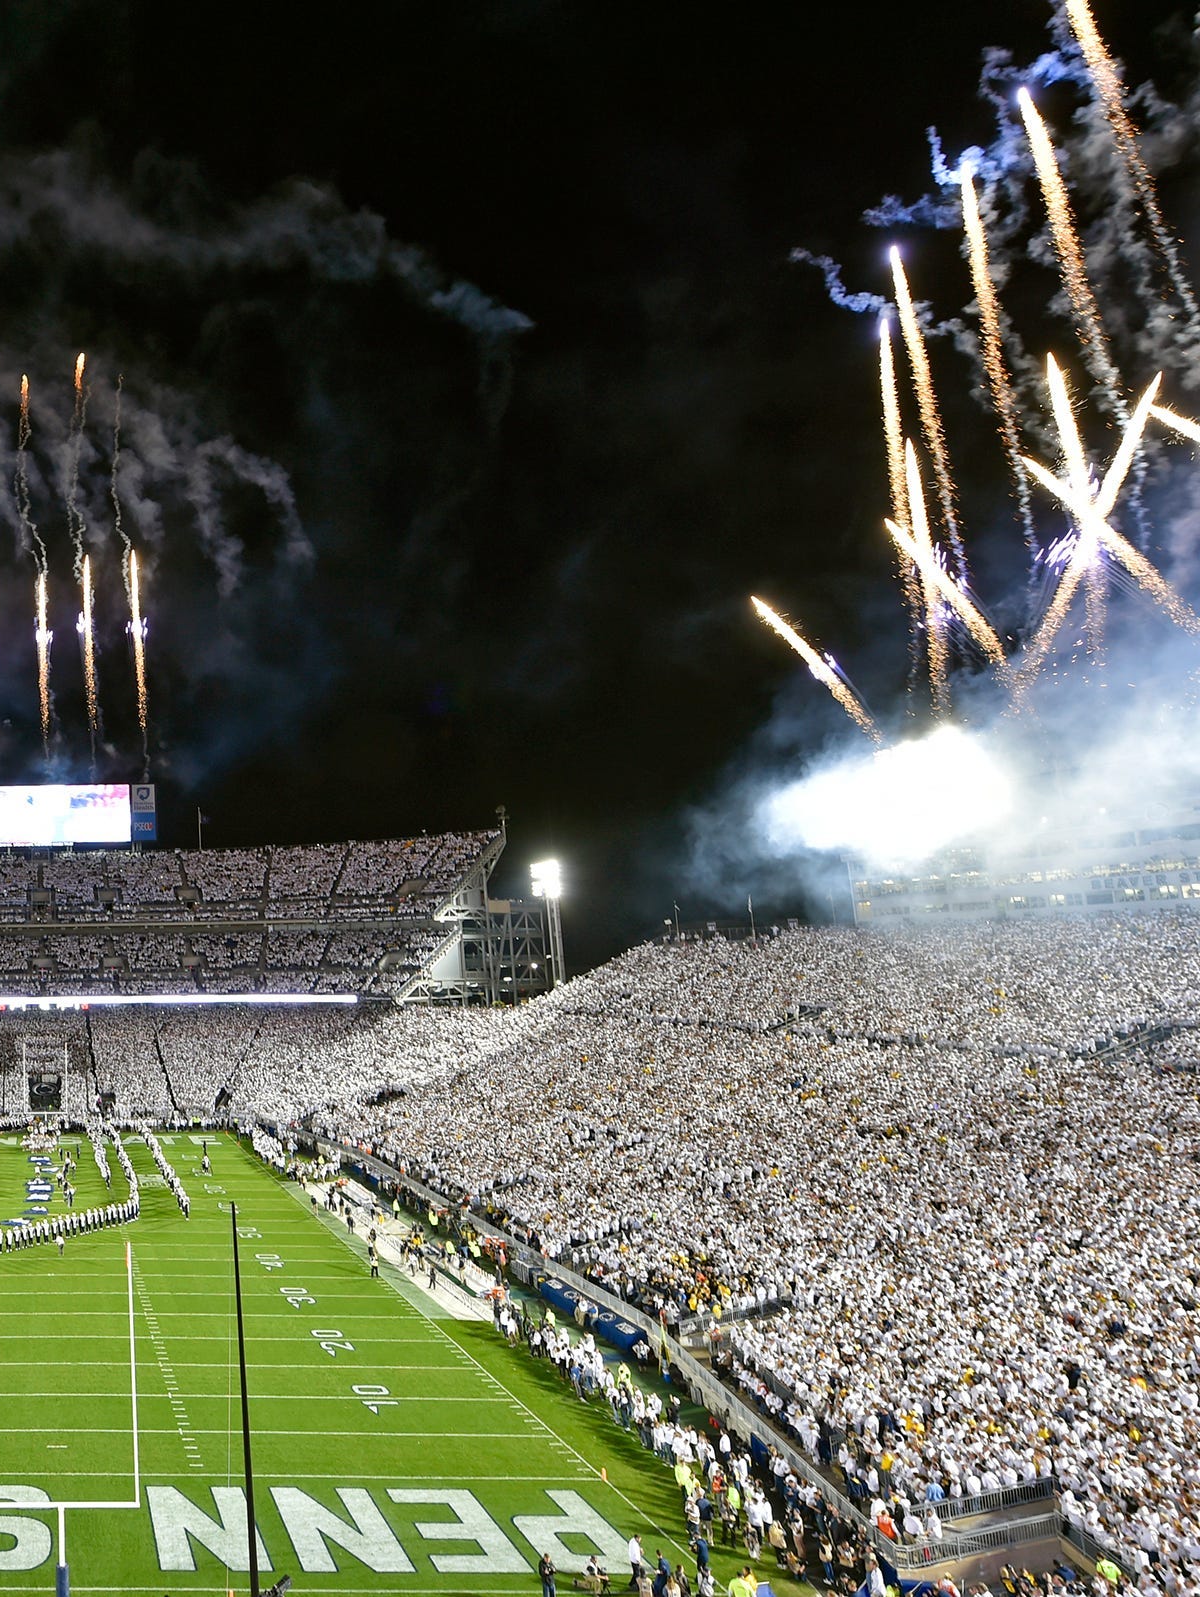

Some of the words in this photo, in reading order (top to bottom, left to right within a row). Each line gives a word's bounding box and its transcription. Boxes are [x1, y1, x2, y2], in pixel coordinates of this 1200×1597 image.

[1091, 874, 1167, 889] BEAVER
[236, 1226, 262, 1238] 50
[255, 1253, 284, 1268] 40
[279, 1286, 316, 1305] 30
[310, 1329, 355, 1351] 20
[351, 1384, 399, 1406] 10
[144, 1485, 656, 1575] PENN
